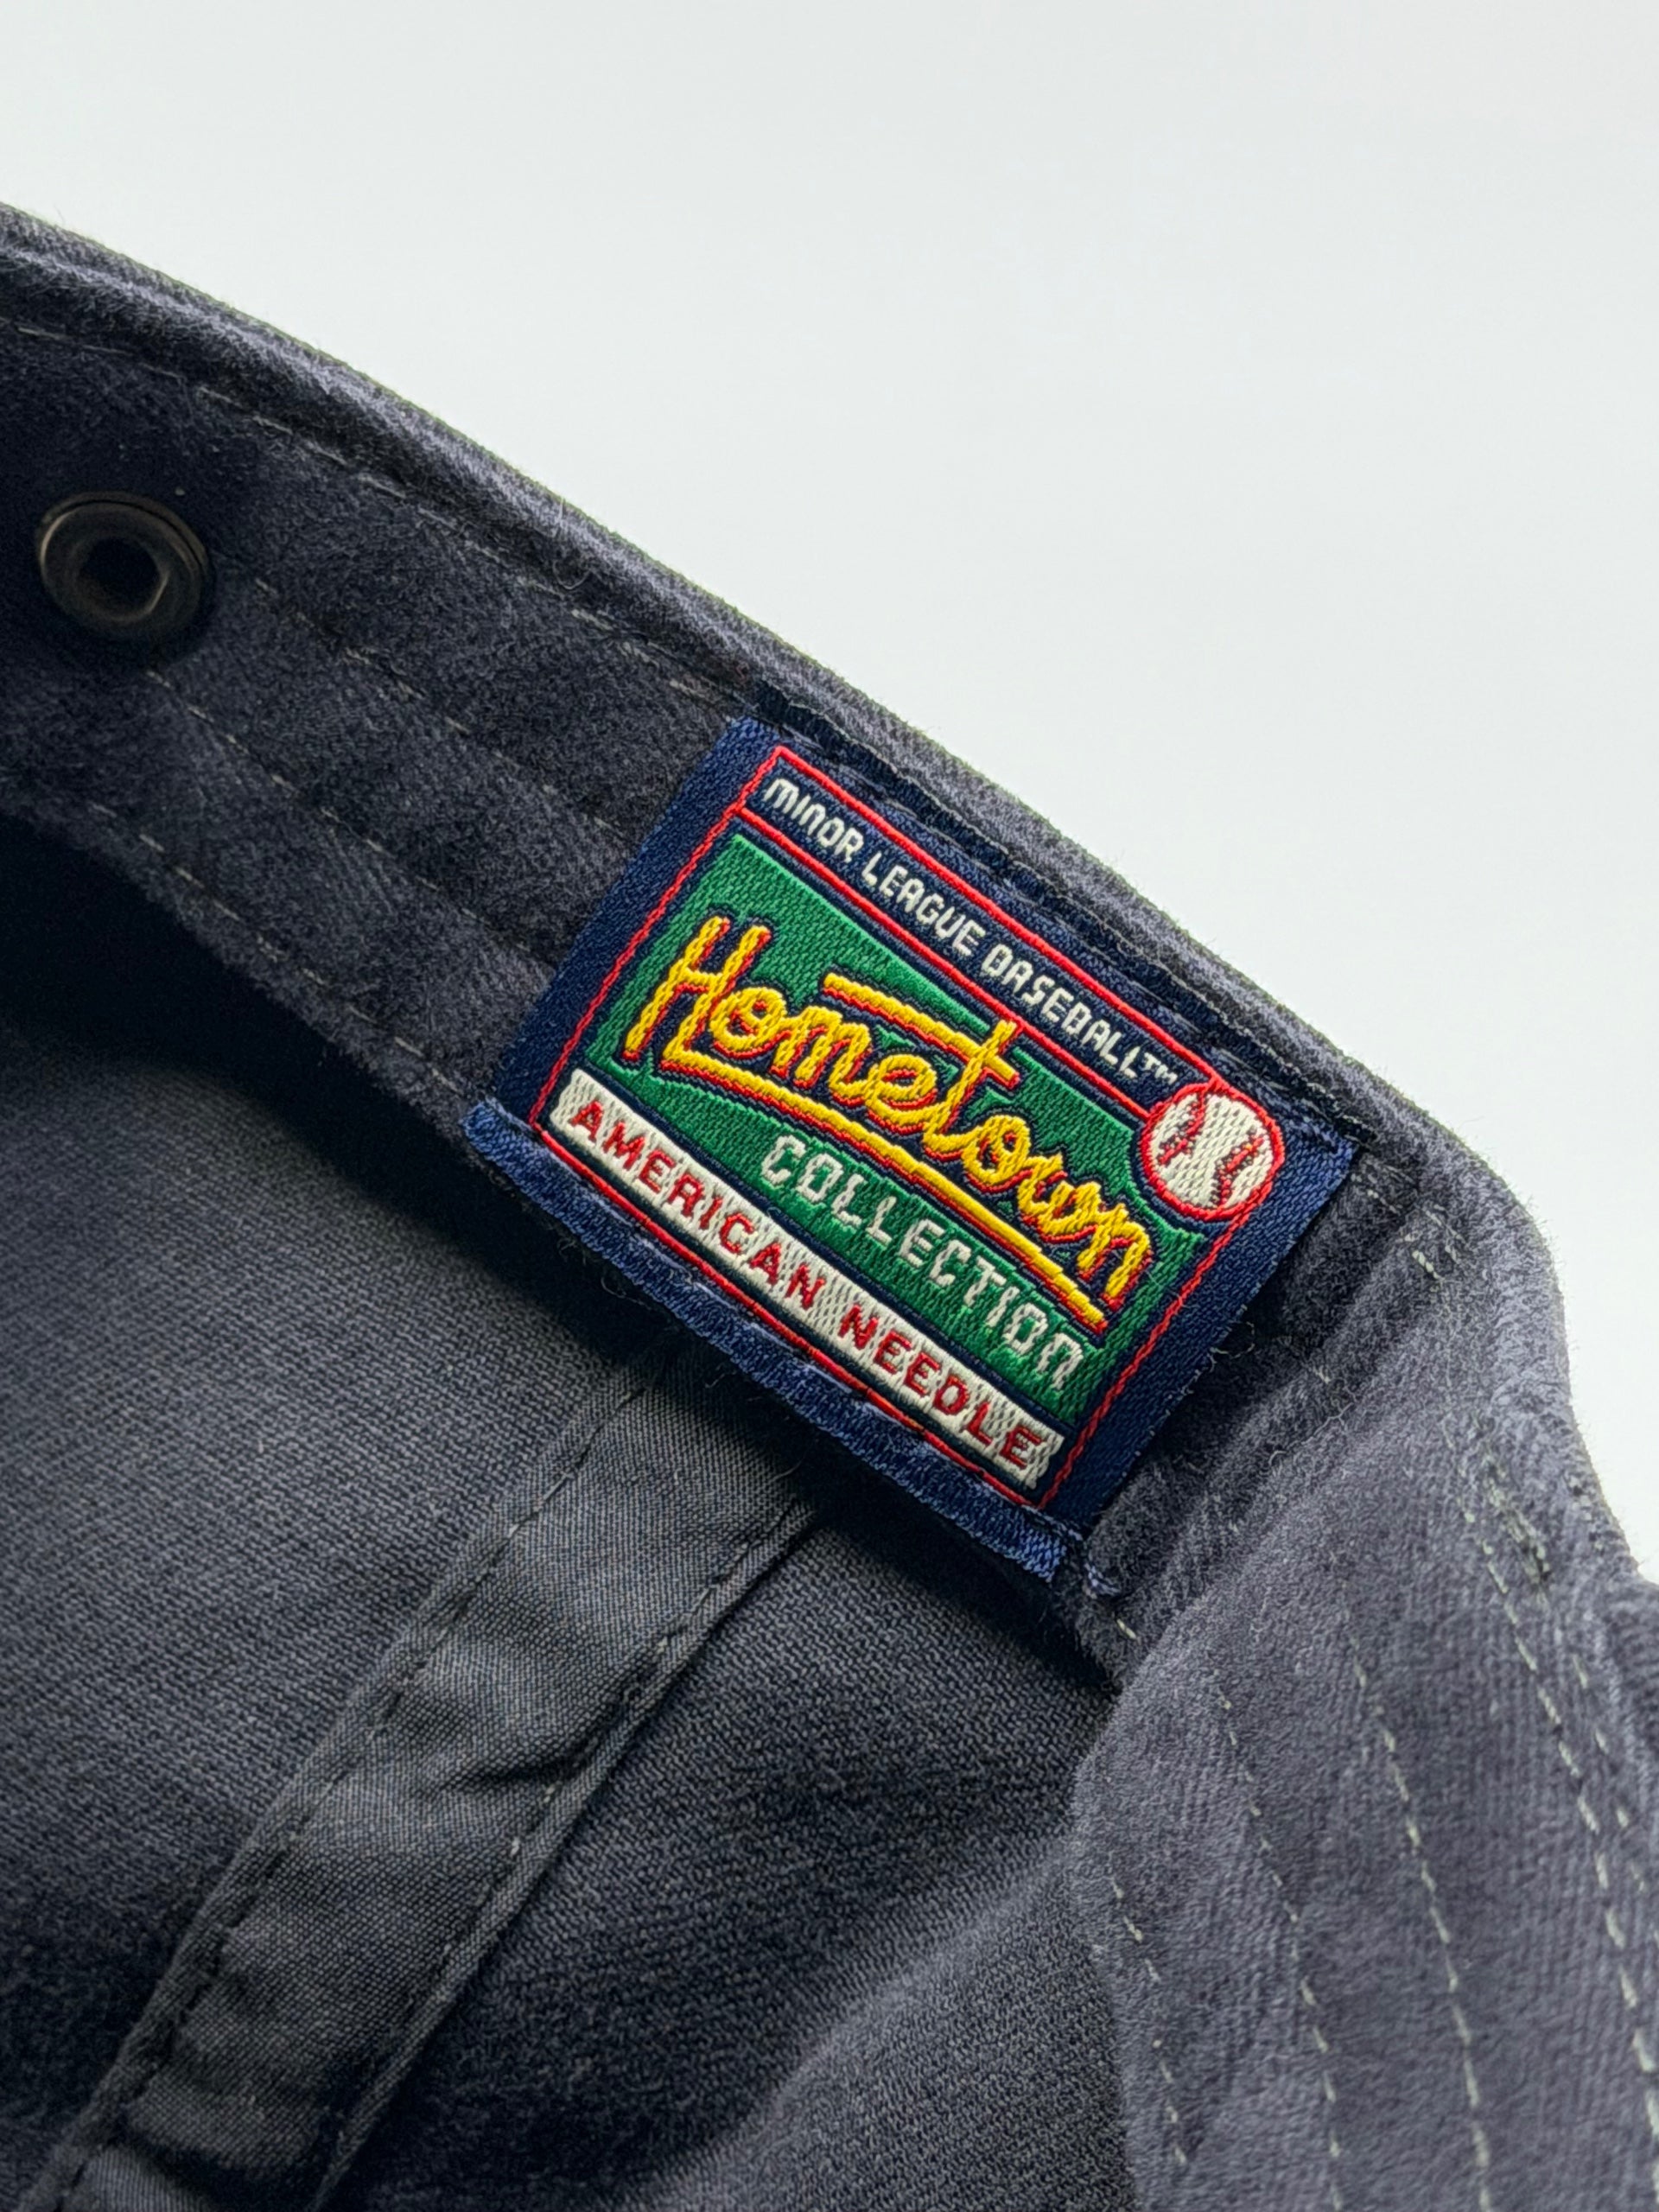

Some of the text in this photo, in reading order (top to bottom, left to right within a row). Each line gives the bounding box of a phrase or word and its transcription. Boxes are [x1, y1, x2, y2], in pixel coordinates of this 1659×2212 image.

[765, 778, 863, 862] MINOR
[863, 852, 987, 957] LEAGUE
[622, 915, 1153, 1333] Hometown
[760, 1135, 1084, 1389] COLLECTION
[569, 1099, 1042, 1470] AMERICAN NEEDLE
